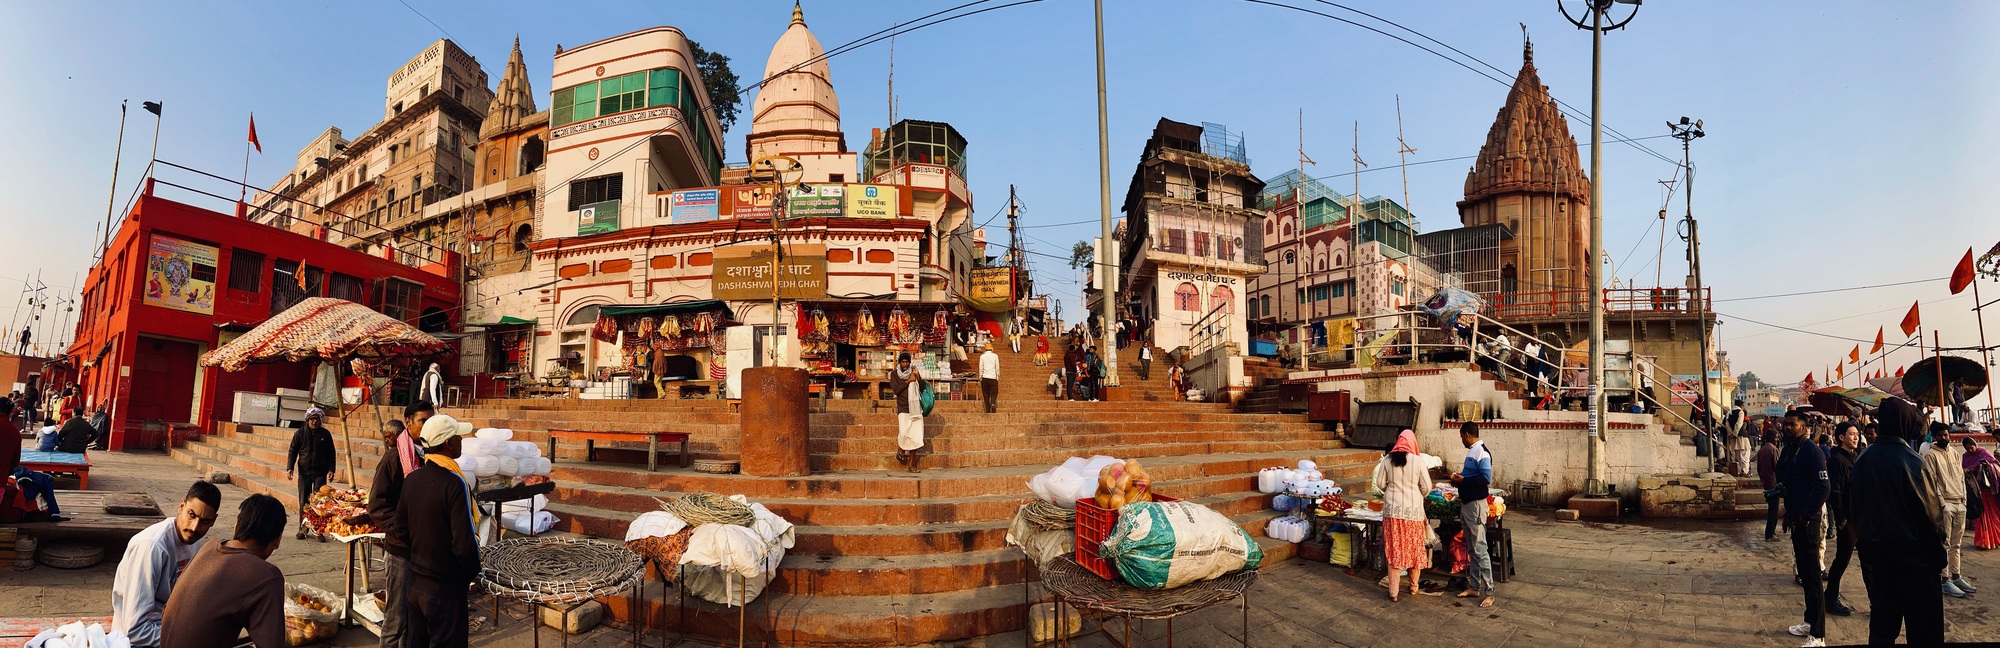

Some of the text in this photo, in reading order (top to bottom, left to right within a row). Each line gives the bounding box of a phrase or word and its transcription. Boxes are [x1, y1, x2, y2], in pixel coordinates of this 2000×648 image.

[857, 198, 886, 206] यूको बैंक
[788, 264, 812, 276] घाट
[718, 280, 820, 290] DASHASHVAEDH GHAT
[1221, 277, 1236, 285] घट
